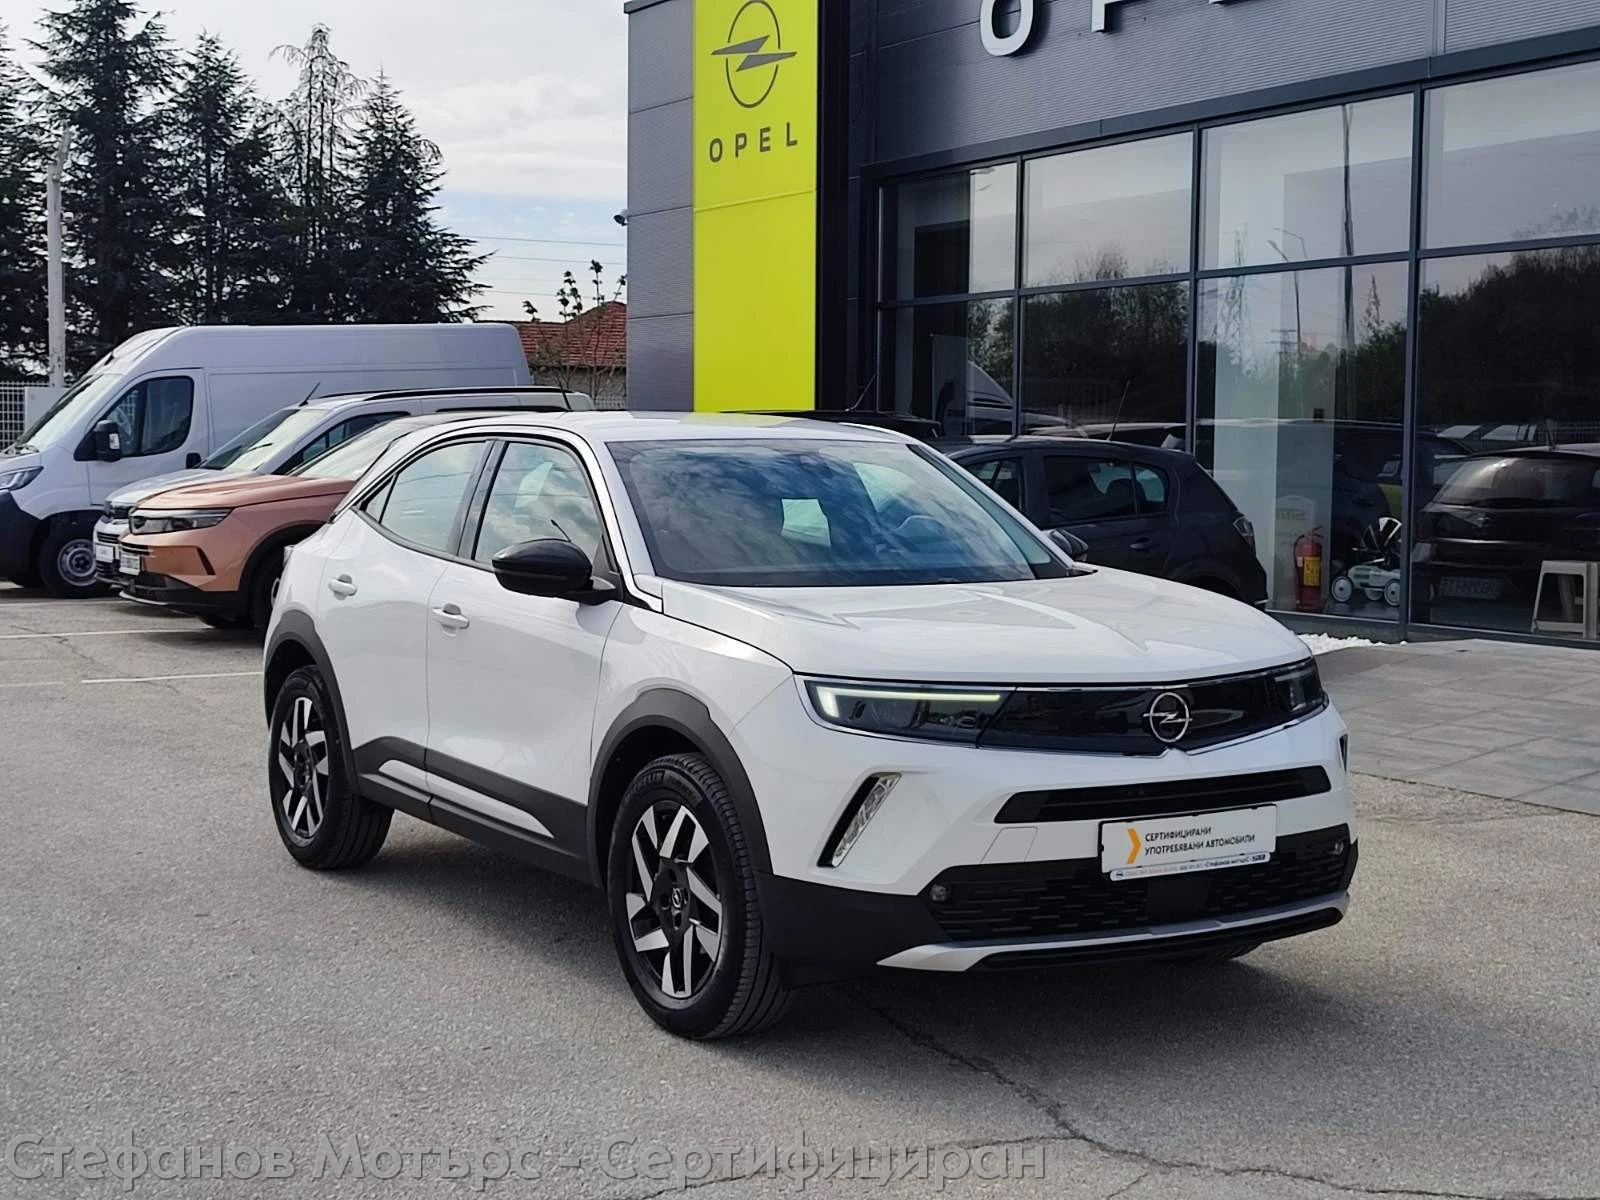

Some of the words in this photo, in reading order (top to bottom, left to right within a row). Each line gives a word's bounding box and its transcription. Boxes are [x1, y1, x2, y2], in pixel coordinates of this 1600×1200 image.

[709, 122, 798, 163] OPEL
[1144, 841, 1204, 856] УПОТРЕБЯВАНИ
[1205, 834, 1256, 849] АВТОМОБИЛИ
[1145, 827, 1212, 842] СЕРТИФИЦИРАНИ
